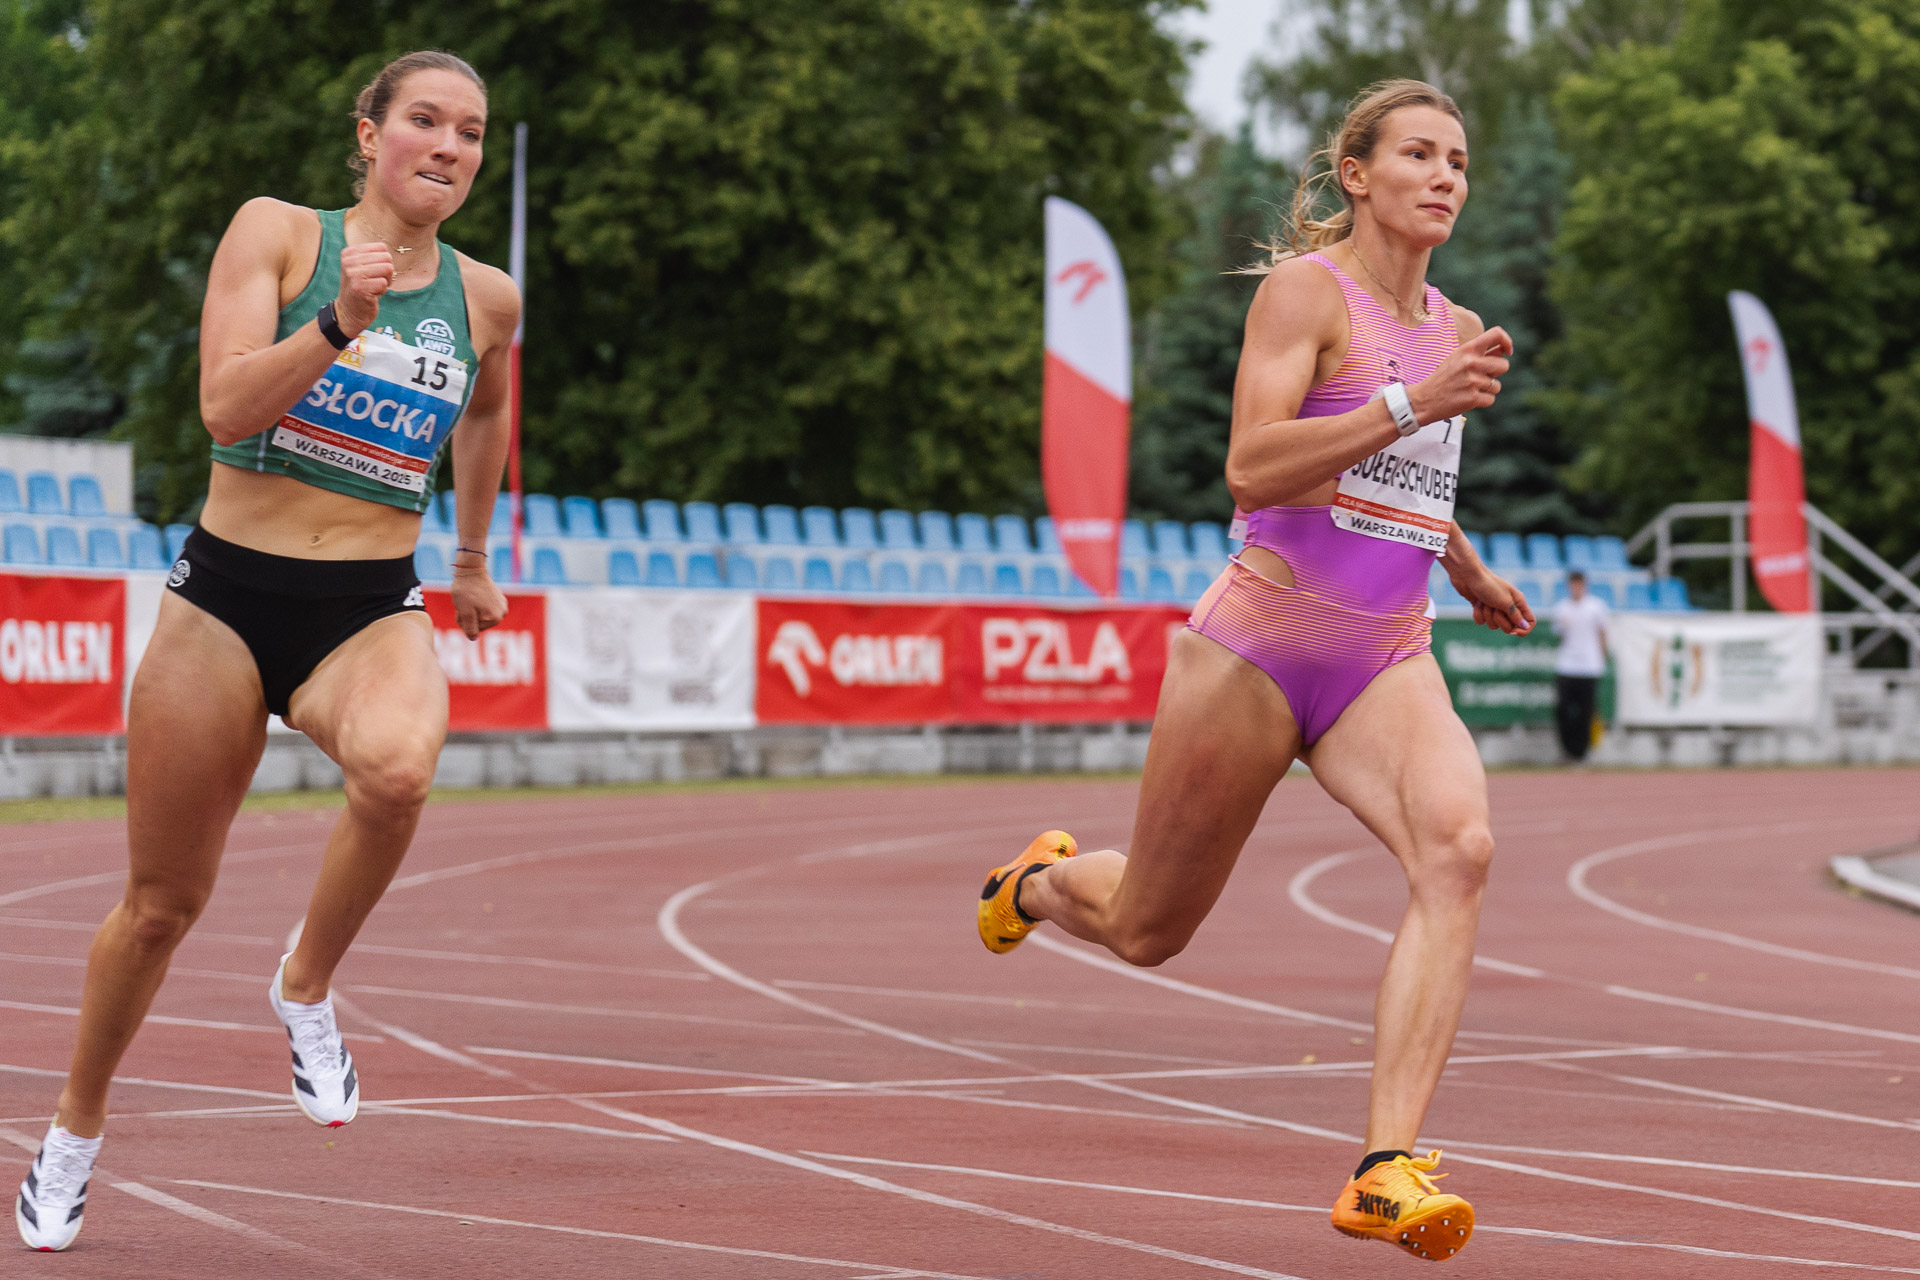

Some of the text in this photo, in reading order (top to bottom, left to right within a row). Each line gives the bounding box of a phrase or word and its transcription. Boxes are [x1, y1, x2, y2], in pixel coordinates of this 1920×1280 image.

[411, 356, 449, 391] 15
[305, 377, 437, 443] SŁOCKA
[295, 438, 411, 485] WARSZAWA 2025
[1351, 516, 1426, 544] WARSZAWA
[0, 617, 112, 685] ORLEN
[829, 634, 943, 687] ORLEN
[981, 617, 1132, 682] PZLA
[1349, 1189, 1400, 1222] NITRO
